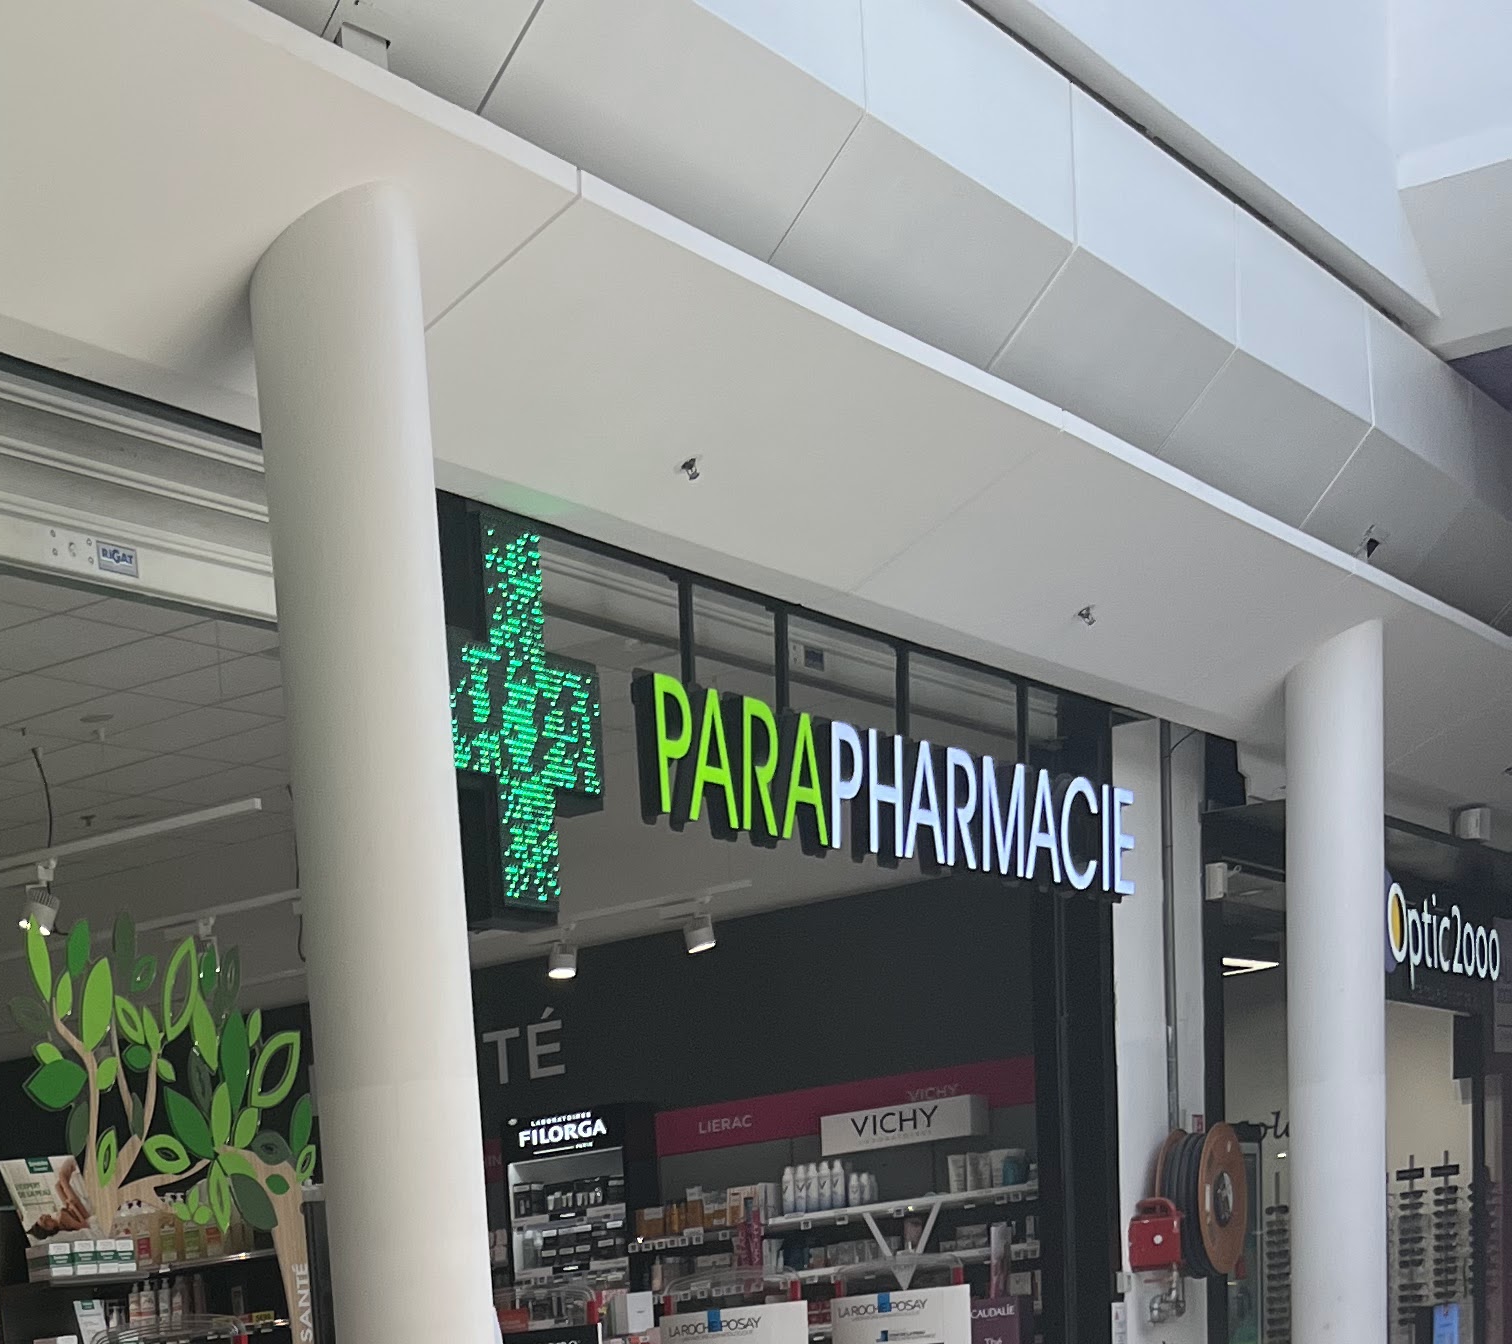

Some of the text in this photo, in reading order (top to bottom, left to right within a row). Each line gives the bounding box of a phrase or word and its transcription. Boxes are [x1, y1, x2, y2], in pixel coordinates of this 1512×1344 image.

[101, 546, 134, 565] RIGAT
[652, 672, 1138, 896] PARAPHARMACIE
[482, 1006, 565, 1085] TÉ
[518, 1118, 607, 1147] FILORGA
[698, 1113, 753, 1135] LIERAC
[851, 1105, 938, 1137] VICHY
[291, 1262, 313, 1342] SANTÉ
